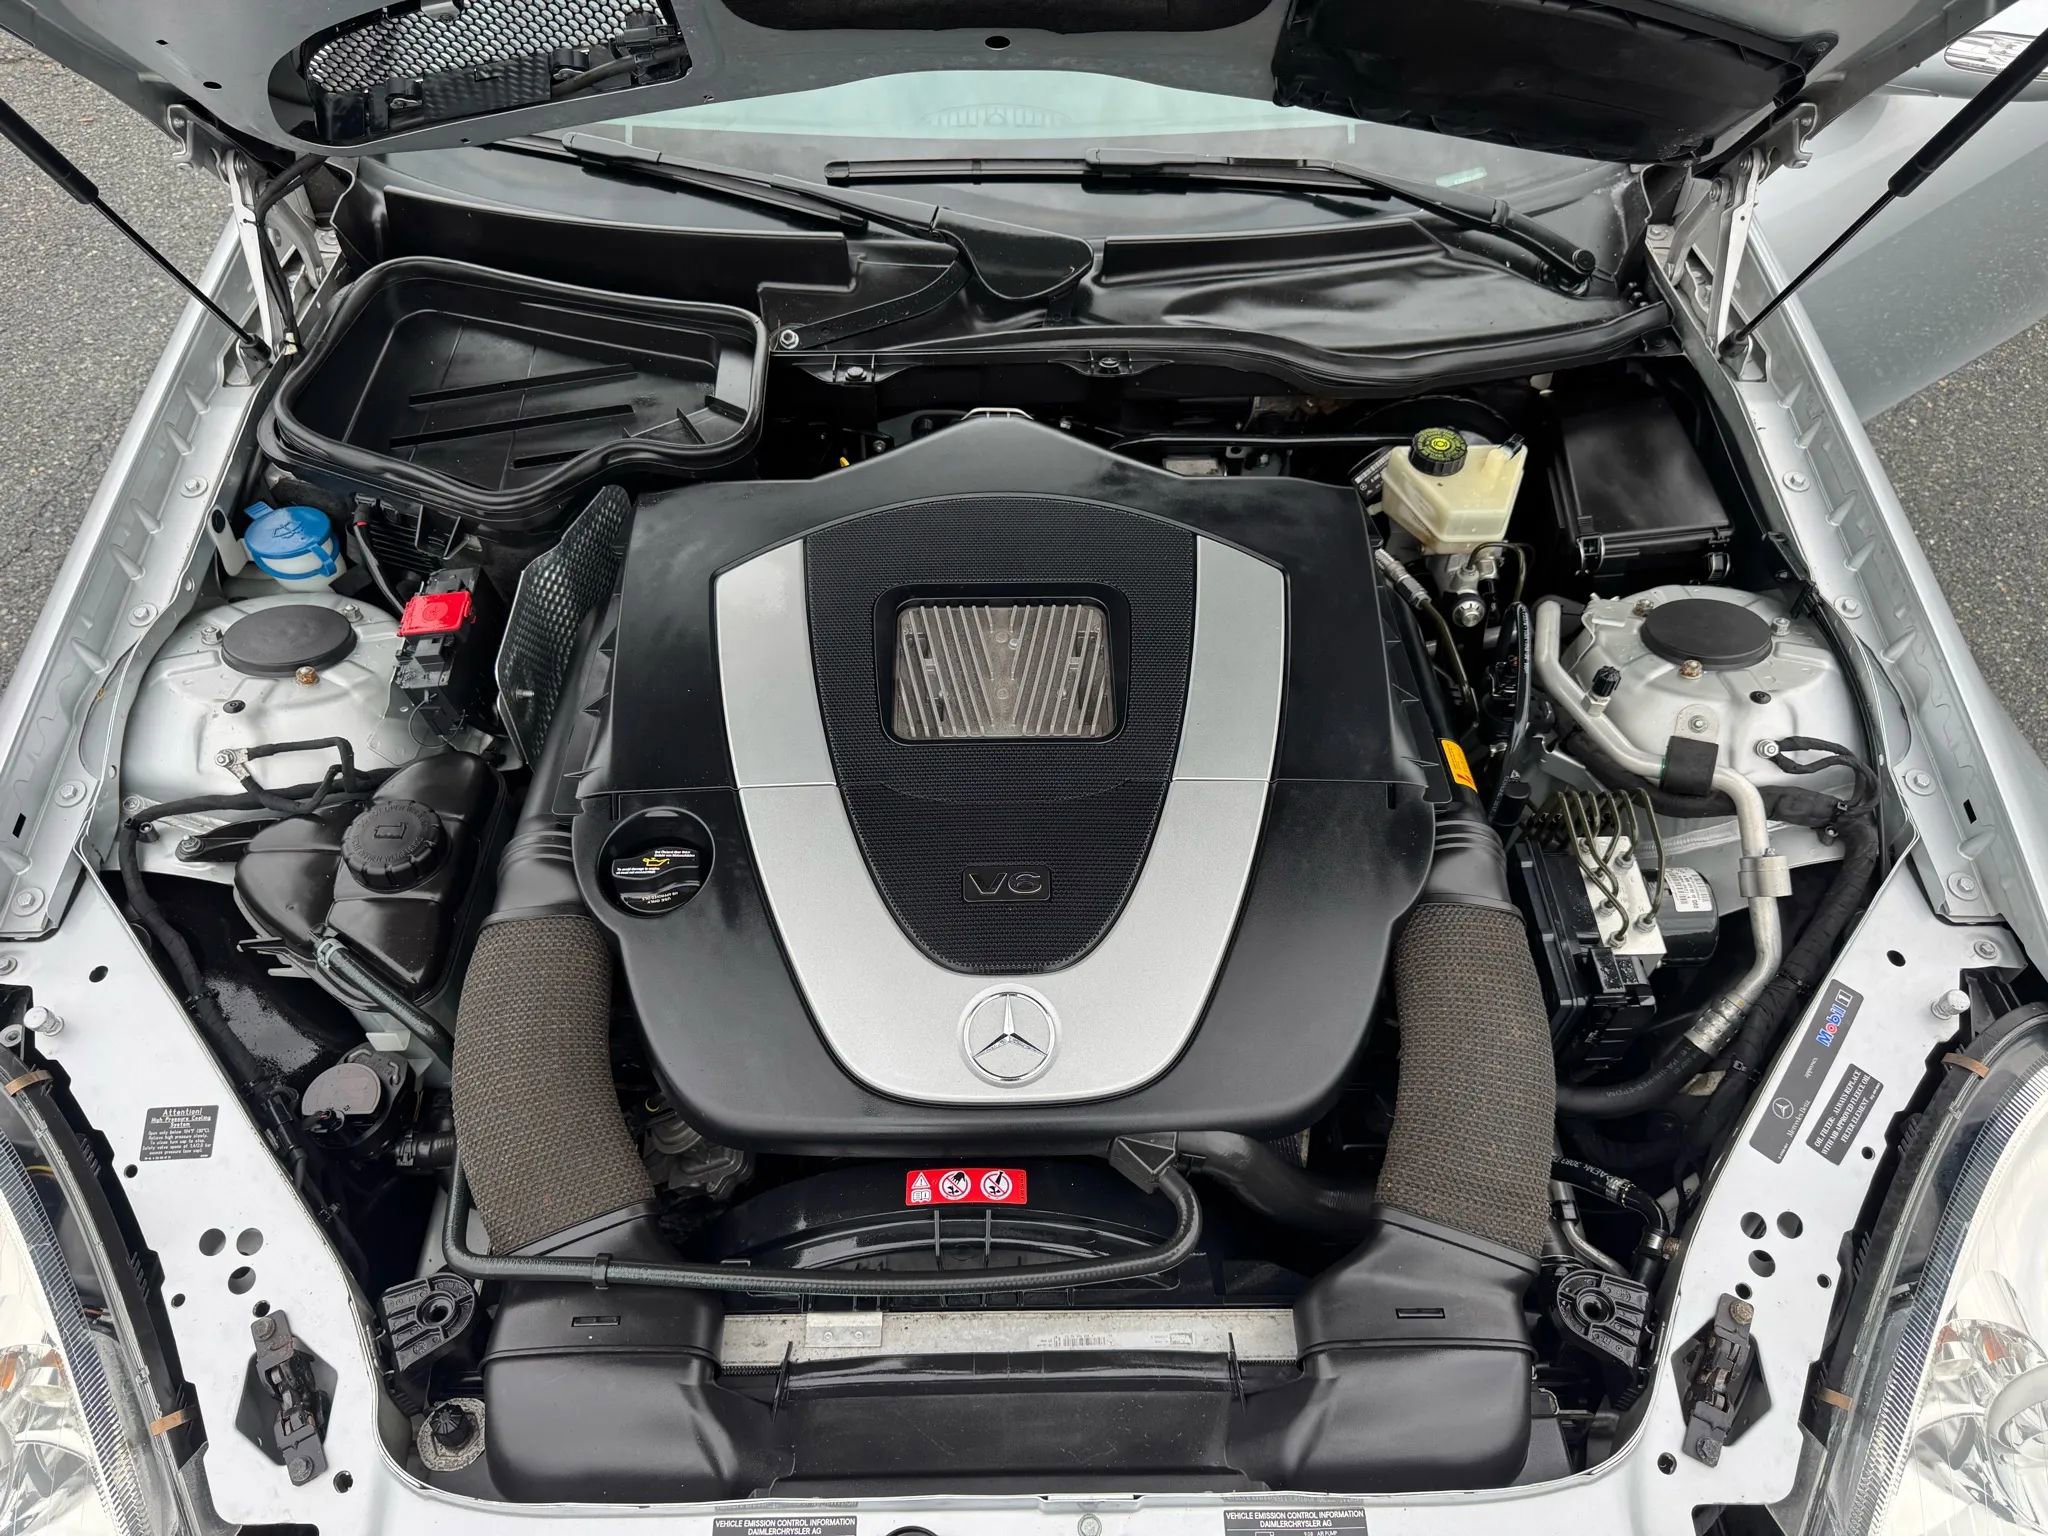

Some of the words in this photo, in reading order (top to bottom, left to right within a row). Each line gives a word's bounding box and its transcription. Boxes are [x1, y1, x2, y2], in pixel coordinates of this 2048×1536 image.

[969, 871, 1041, 894] V6
[1815, 1002, 1847, 1047] Mobil
[1814, 1137, 1824, 1147] OIL
[1833, 1093, 1848, 1115] ALWAYS
[1844, 1070, 1861, 1094] REPLACE
[1821, 1139, 1834, 1154] WITH
[1836, 1104, 1854, 1131] APPROVED
[1850, 1083, 1865, 1104] FLEECE
[1841, 1123, 1855, 1142] FILTER
[1851, 1097, 1868, 1124] ELEMENT
[715, 1520, 743, 1528] VEHICLE
[743, 1519, 775, 1527] EMISSION
[777, 1518, 807, 1527] CONTROL
[809, 1517, 855, 1526] INFORMATION
[1225, 1512, 1254, 1520] VEHICLE
[1254, 1512, 1286, 1520] EMISSION
[1287, 1511, 1317, 1519] CONTROL
[1319, 1510, 1364, 1519] INFORMATION
[1260, 1520, 1321, 1528] DAIMLERCHRYSLER
[1322, 1519, 1332, 1527] AG
[747, 1528, 811, 1536] DAIMLERCHRYSLER
[811, 1527, 822, 1535] AG
